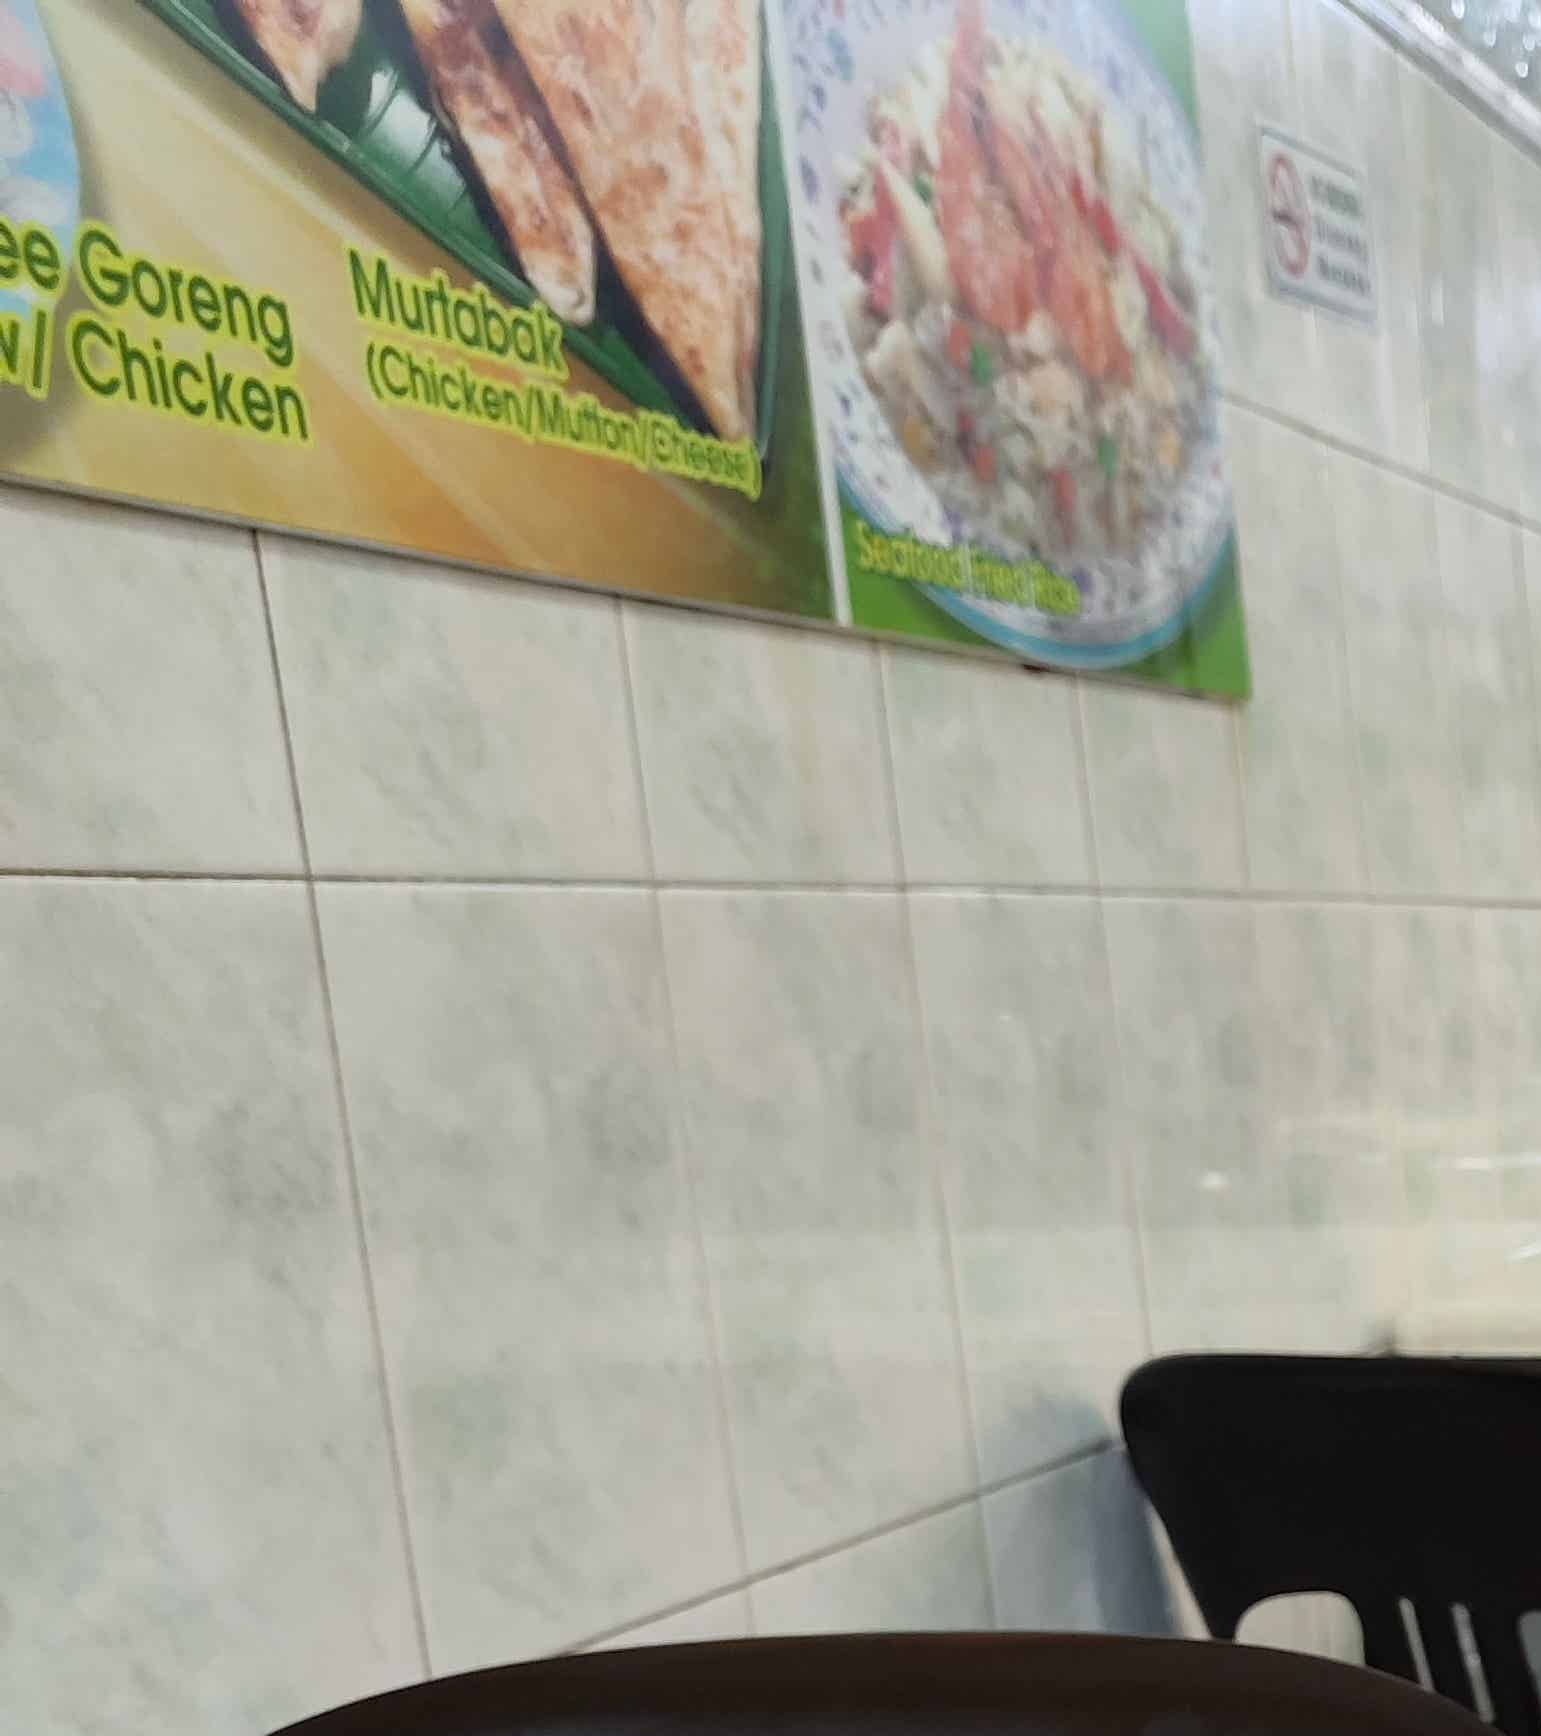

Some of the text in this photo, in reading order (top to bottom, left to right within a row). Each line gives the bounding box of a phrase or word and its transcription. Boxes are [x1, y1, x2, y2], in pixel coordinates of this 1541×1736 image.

[79, 229, 294, 367] Goreng
[350, 249, 567, 374] Murtabak
[72, 319, 308, 440] Chicken
